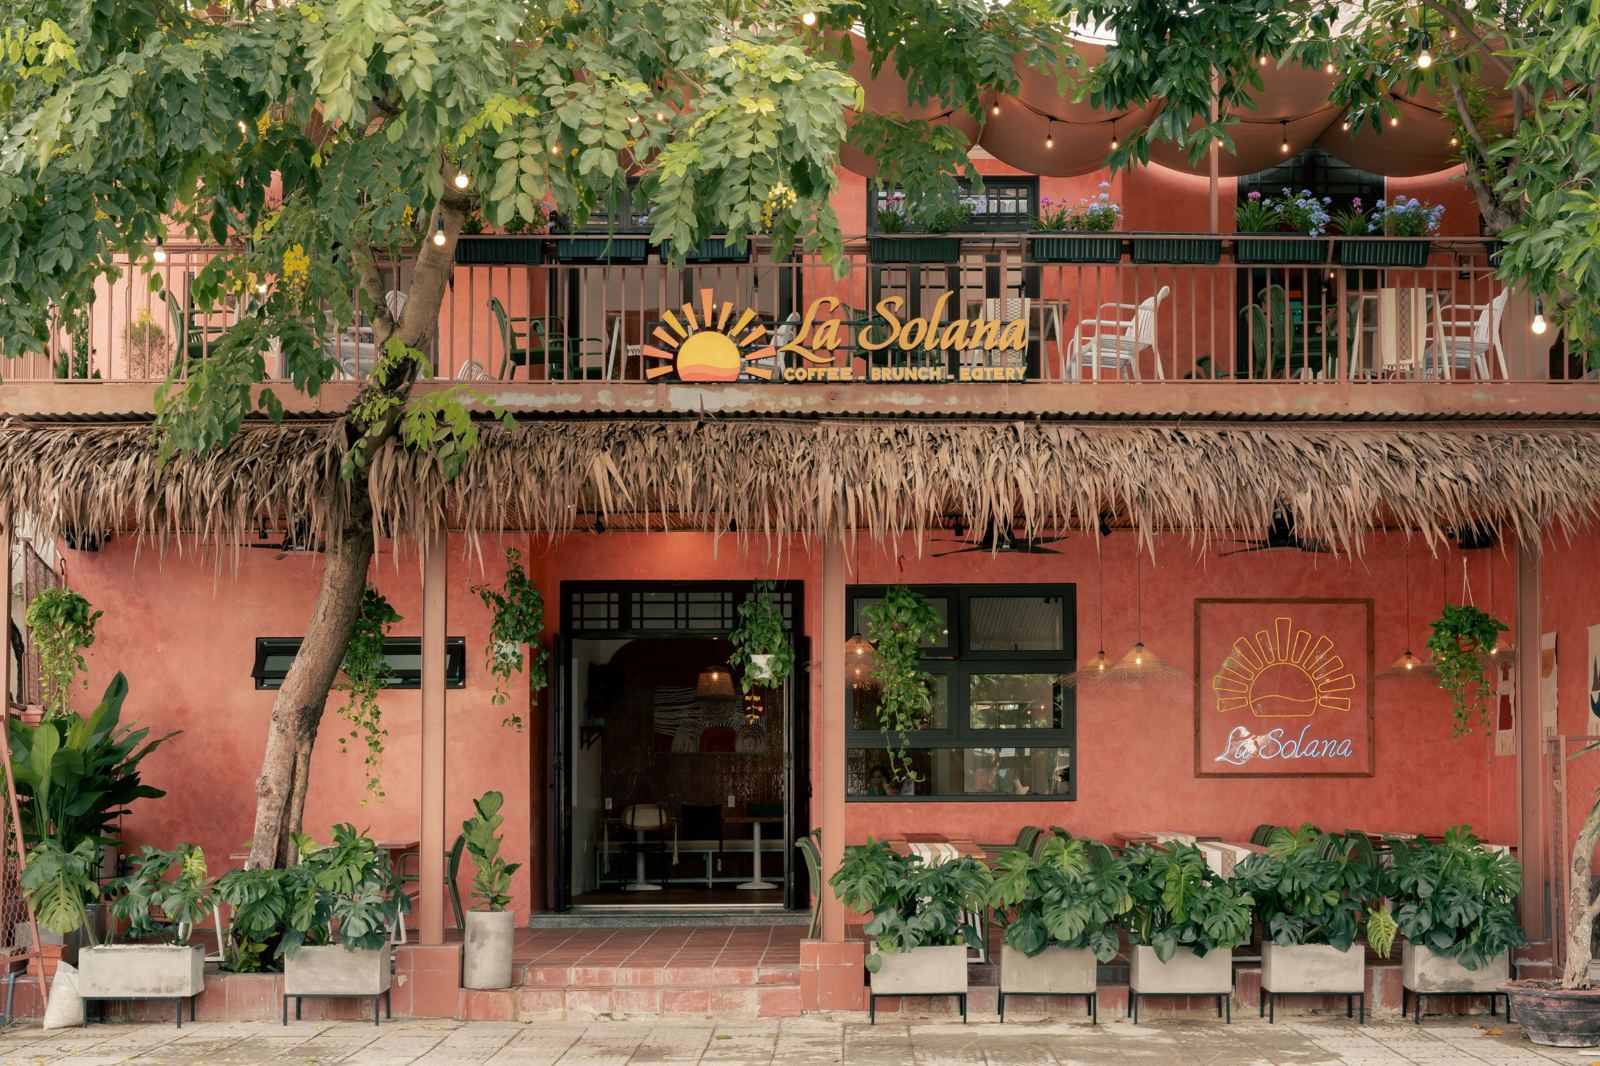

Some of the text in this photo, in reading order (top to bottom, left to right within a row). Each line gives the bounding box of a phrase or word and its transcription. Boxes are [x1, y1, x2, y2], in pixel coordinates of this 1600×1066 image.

[780, 290, 1028, 362] La Solana
[783, 367, 853, 381] COFFEE
[872, 367, 942, 381] BRUNCH
[1214, 724, 1353, 765] La Solana
